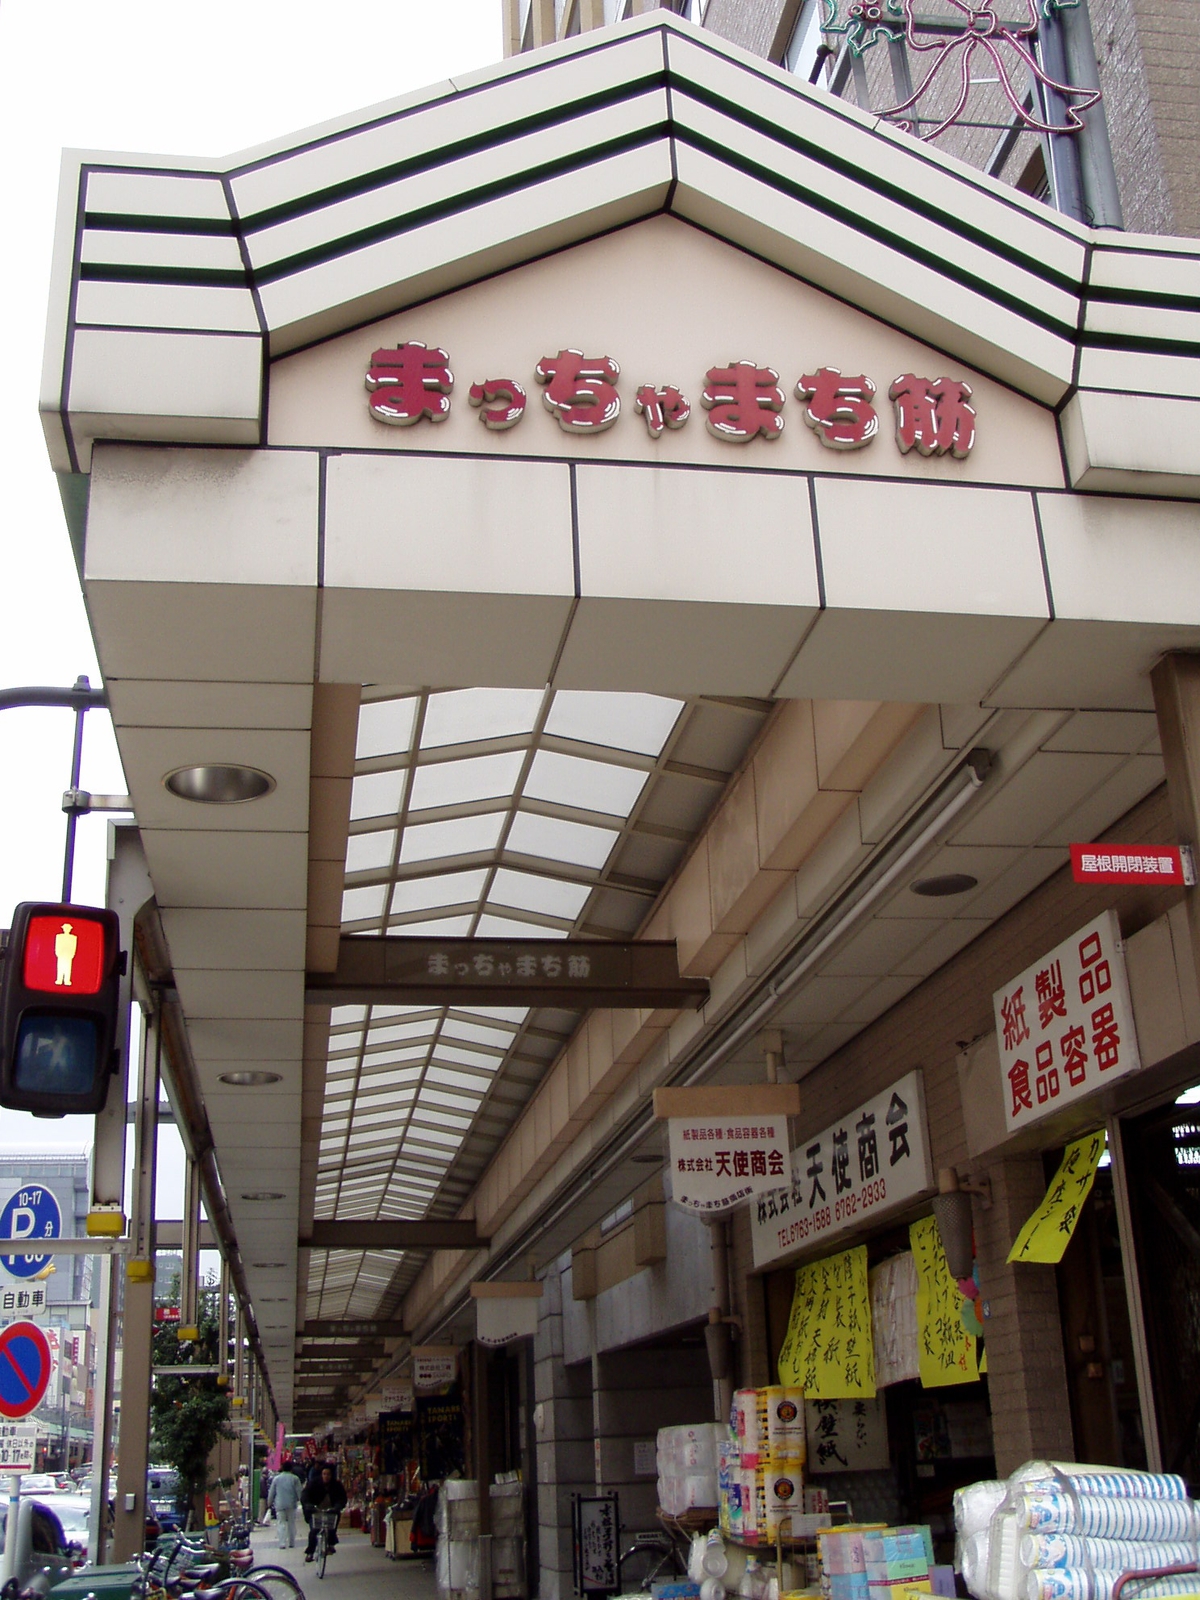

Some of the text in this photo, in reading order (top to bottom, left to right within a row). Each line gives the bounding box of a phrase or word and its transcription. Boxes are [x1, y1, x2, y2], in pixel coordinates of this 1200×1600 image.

[365, 339, 977, 460] まっちゃまち筋
[1081, 854, 1174, 875] 屋根開閉装置
[428, 953, 591, 979] まっちゃまち筋
[1001, 931, 1112, 1051] 紙製品
[1007, 1002, 1120, 1117] 食品容器
[18, 1190, 43, 1207] 10-17
[3, 1289, 44, 1309] 自動車
